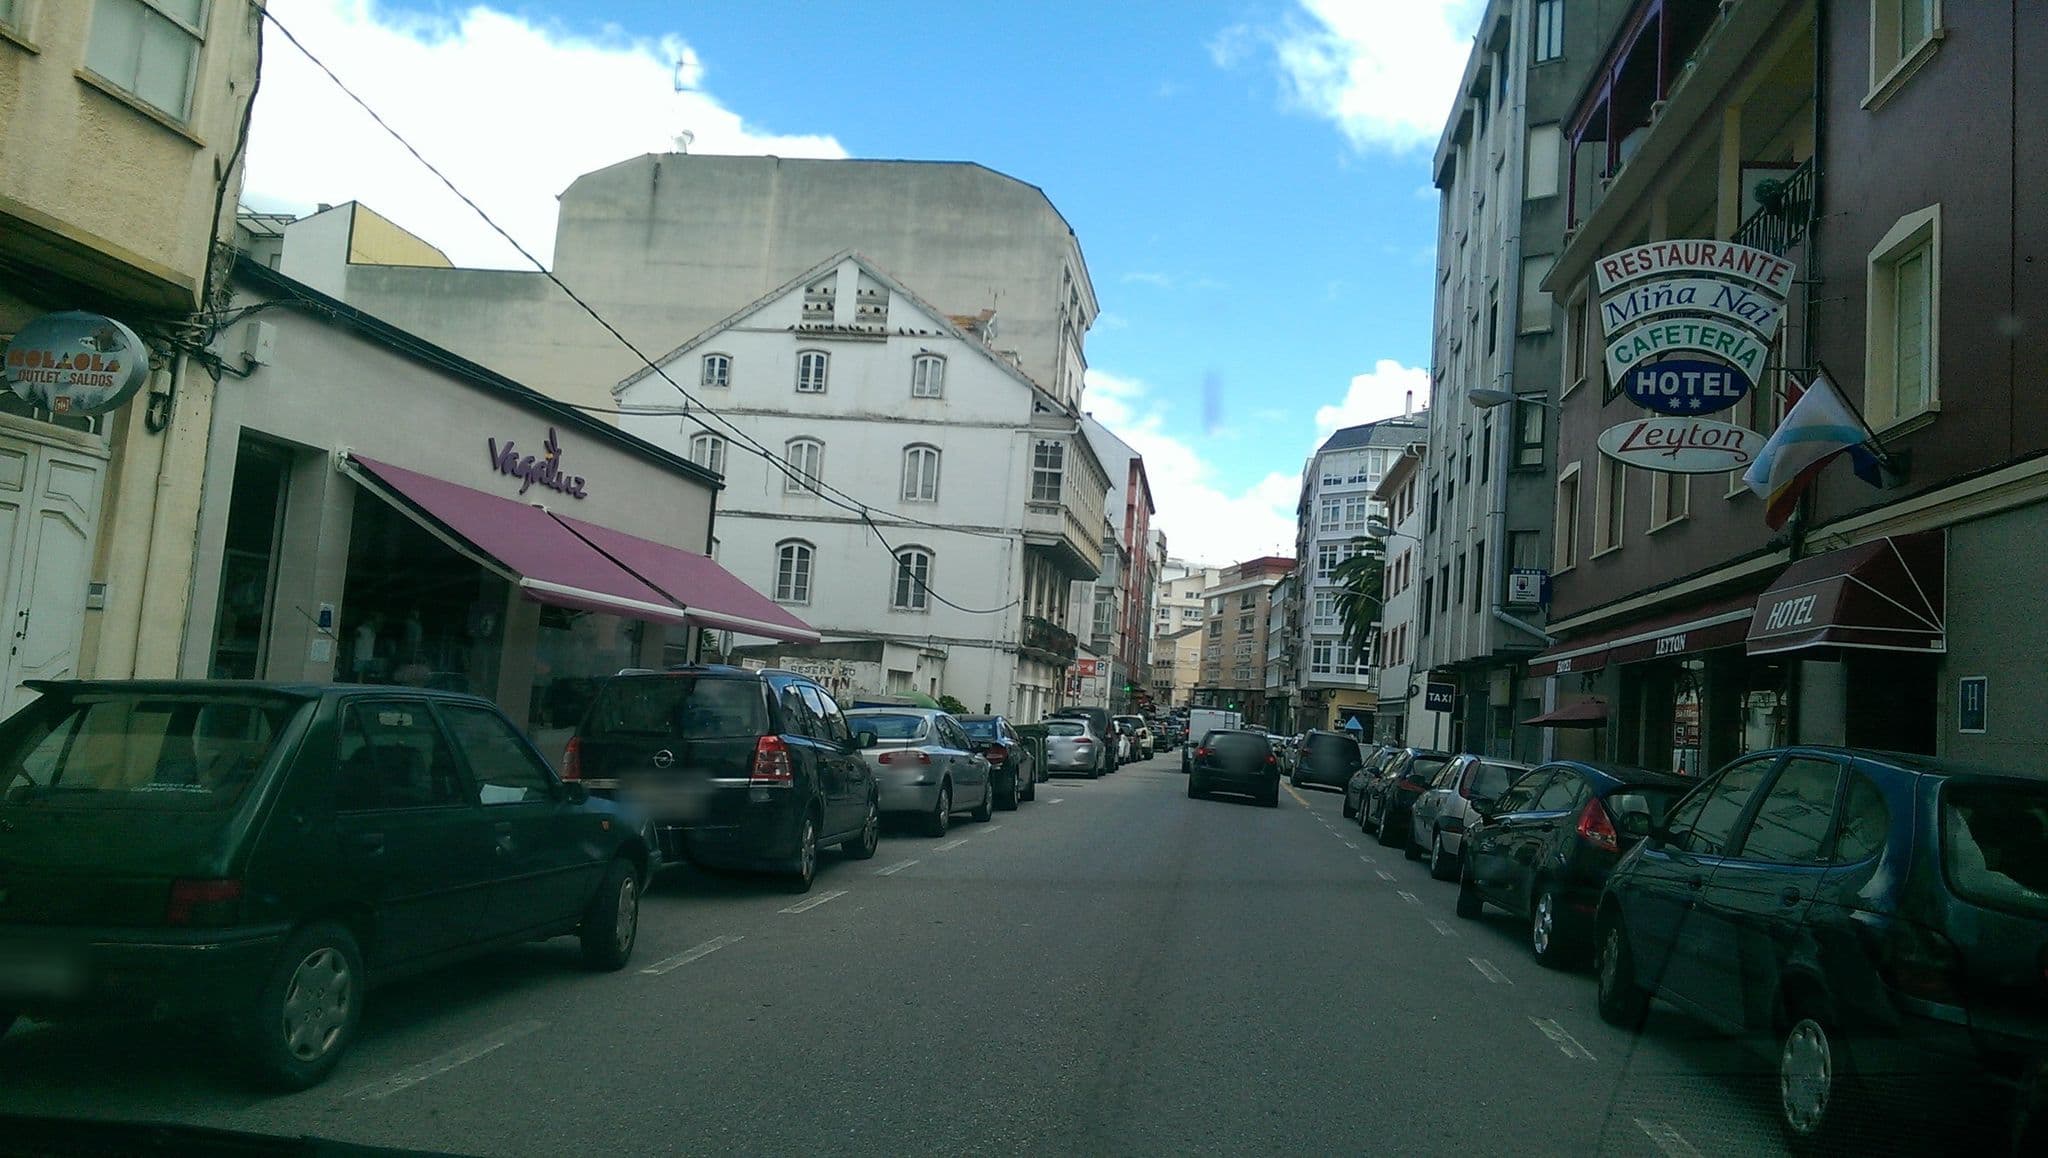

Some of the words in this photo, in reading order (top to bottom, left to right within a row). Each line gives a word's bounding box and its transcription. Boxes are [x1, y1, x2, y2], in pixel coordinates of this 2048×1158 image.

[1602, 243, 1790, 286] RESTAURANTE
[1604, 283, 1695, 329] Miña
[1711, 285, 1777, 327] Nai
[1614, 324, 1759, 368] CAFETERÍA
[18, 369, 61, 384] OUTLET
[69, 372, 113, 387] SALDOS
[1636, 371, 1740, 397] HOTEL
[1765, 594, 1817, 631] HOTEL
[1655, 633, 1687, 655] LEYTON
[1428, 692, 1452, 703] TAXI
